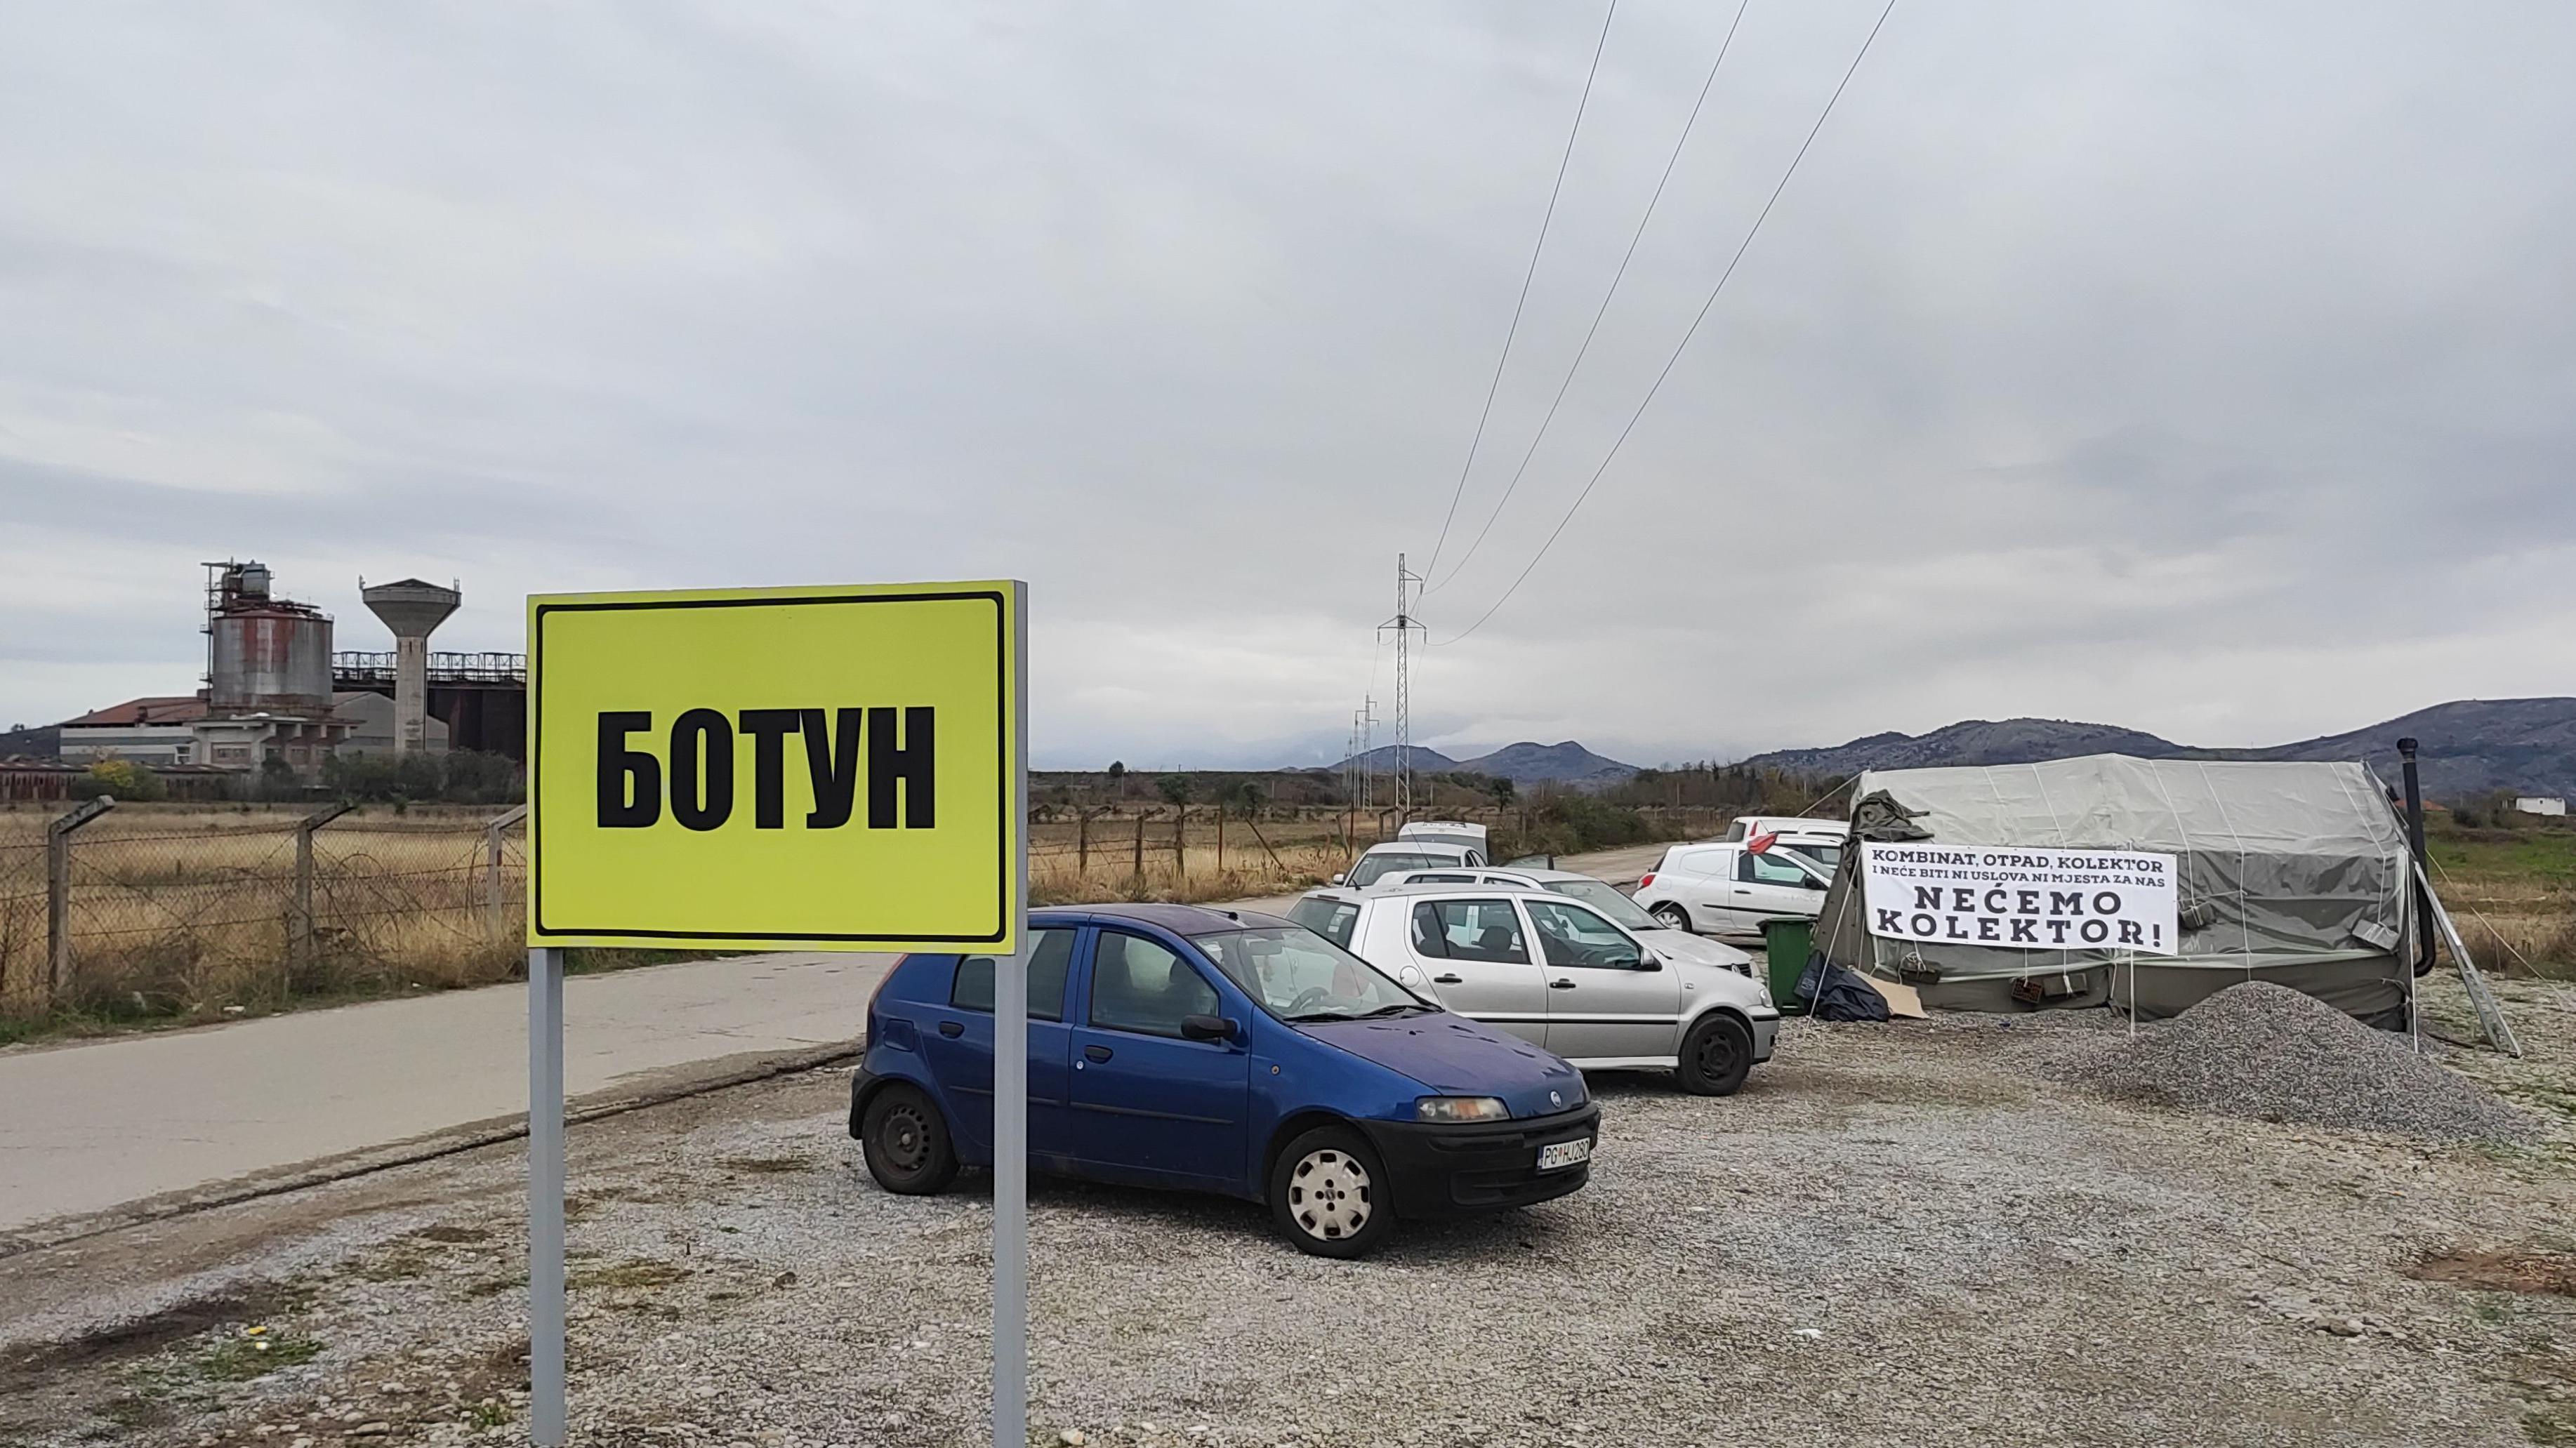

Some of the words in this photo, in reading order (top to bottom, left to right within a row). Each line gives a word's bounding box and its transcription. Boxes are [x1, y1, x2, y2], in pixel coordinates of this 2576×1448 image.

[597, 706, 935, 832] БОТУН
[1872, 849, 1979, 868] KOMBINAT,
[1983, 853, 2054, 870] OTPAD,
[2057, 856, 2164, 873] KOLEKTOR
[1872, 865, 1877, 874] I
[1880, 865, 1917, 877] NEĆE
[1920, 868, 1949, 879] BITI
[1952, 870, 1968, 880] NI
[1971, 871, 2030, 882] USLOVA
[2032, 872, 2048, 883] NI
[2051, 873, 2111, 884] MJESTA
[2113, 875, 2133, 885] ZA
[2135, 876, 2166, 888] NAS
[1914, 882, 2122, 916] NEĆEMO
[1877, 908, 2161, 948] KOLEKTOR!
[1544, 1147, 1558, 1167] PG
